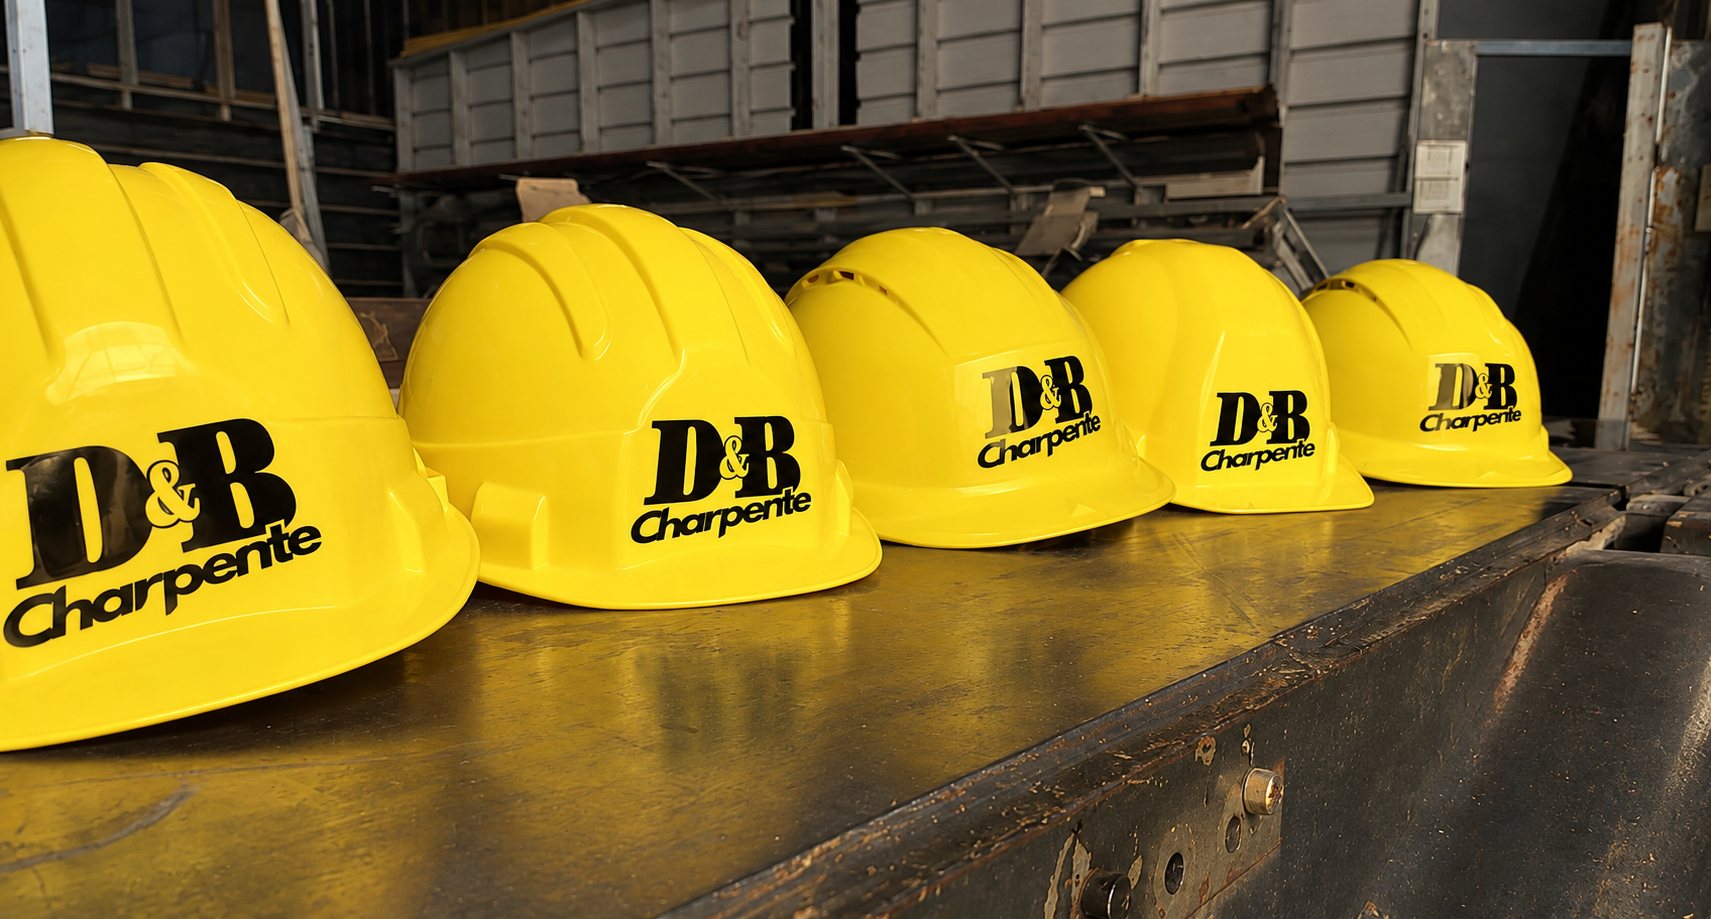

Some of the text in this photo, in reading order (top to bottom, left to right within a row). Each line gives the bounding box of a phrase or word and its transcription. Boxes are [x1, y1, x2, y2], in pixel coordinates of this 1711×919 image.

[982, 355, 1093, 439] D&B
[1428, 363, 1518, 411] D&B
[977, 412, 1101, 469] Charpente
[1209, 390, 1311, 446] D&B
[1420, 408, 1522, 432] Charpente
[643, 415, 801, 505] D&B
[1200, 440, 1315, 472] Charpente
[6, 418, 297, 590] D&B
[630, 488, 812, 544] Charpente
[3, 523, 323, 648] Charpente
